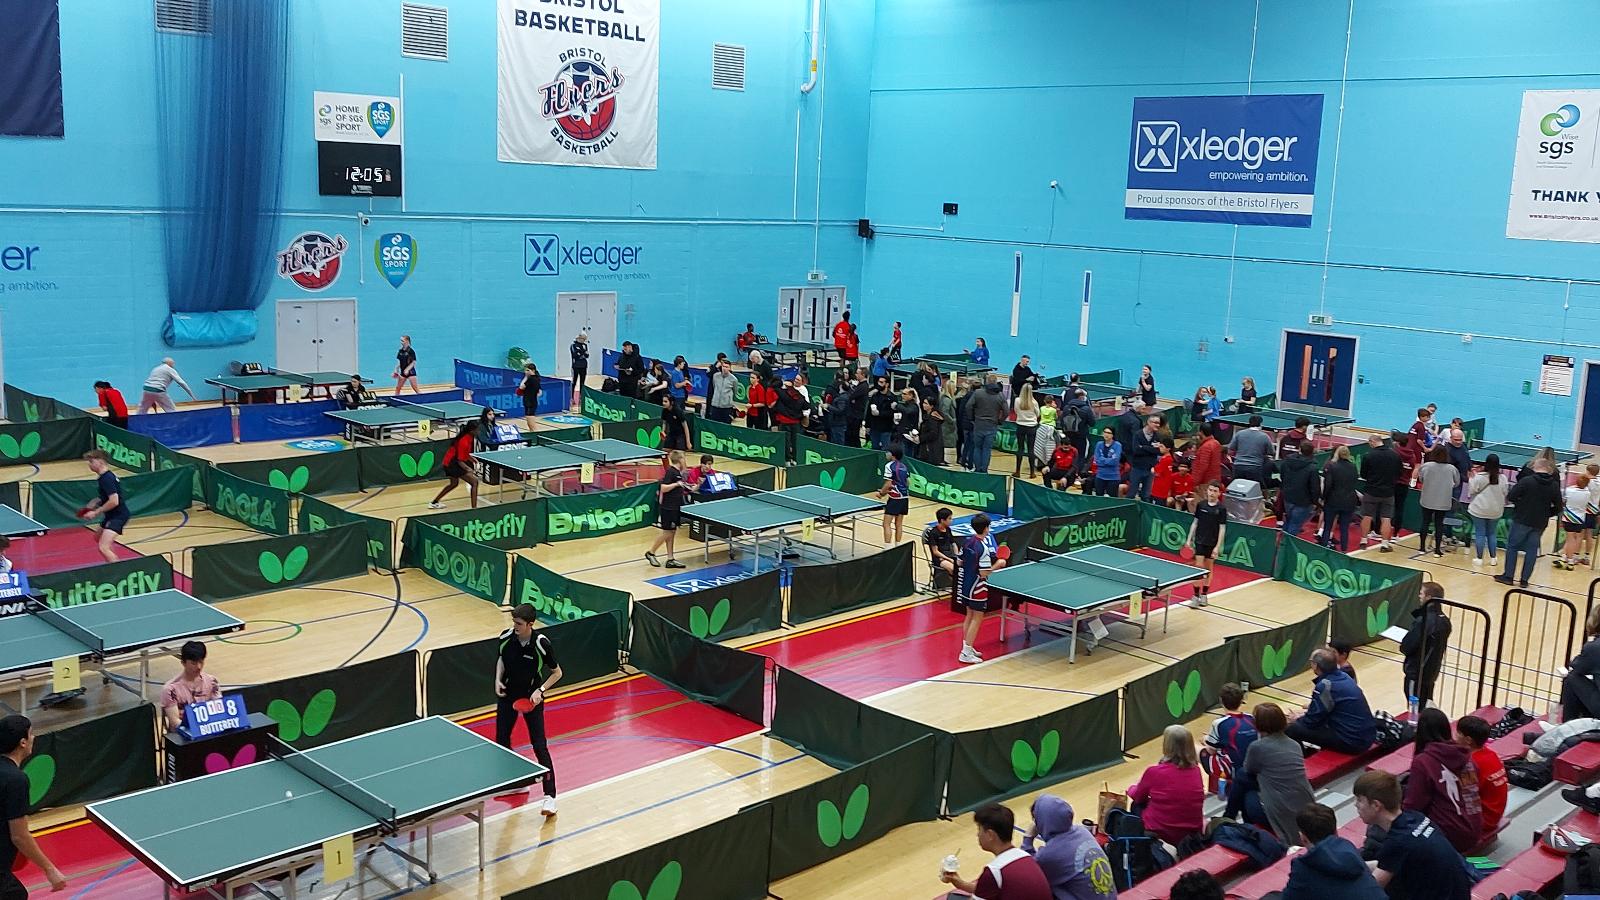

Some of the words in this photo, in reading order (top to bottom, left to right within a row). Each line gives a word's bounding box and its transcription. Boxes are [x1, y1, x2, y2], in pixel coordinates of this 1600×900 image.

[515, 9, 645, 42] BASKETBALL
[559, 47, 607, 68] BRISTOL
[335, 105, 360, 113] HOME
[349, 115, 364, 123] SGS
[372, 110, 390, 120] SGS
[335, 123, 361, 131] SPORT
[550, 127, 619, 155] BASKETBALL
[1180, 128, 1298, 170] xledger
[1539, 141, 1575, 159] sgs
[1209, 171, 1264, 183] empowering
[1137, 194, 1163, 204] Proud
[1165, 195, 1205, 206] sponsors
[1207, 194, 1218, 206] of
[1219, 195, 1235, 207] the
[1237, 197, 1268, 208] Bristol
[1270, 198, 1300, 210] Flyers
[1531, 189, 1590, 203] THANK
[382, 247, 410, 261] SGS
[561, 240, 643, 271] xledger
[584, 273, 623, 281] empowering
[585, 396, 627, 422] Bribar
[97, 433, 147, 468] Bribar
[700, 431, 776, 459] Bribar
[909, 472, 995, 507] Bribar
[216, 483, 277, 530] JOOLA
[549, 503, 651, 536] Bribar
[1069, 518, 1127, 544] Butterfly
[423, 539, 493, 596] JOOLA
[63, 666, 71, 679] 2
[193, 705, 209, 723] 10
[226, 699, 238, 716] 8
[200, 717, 240, 735] BUTTERFLY
